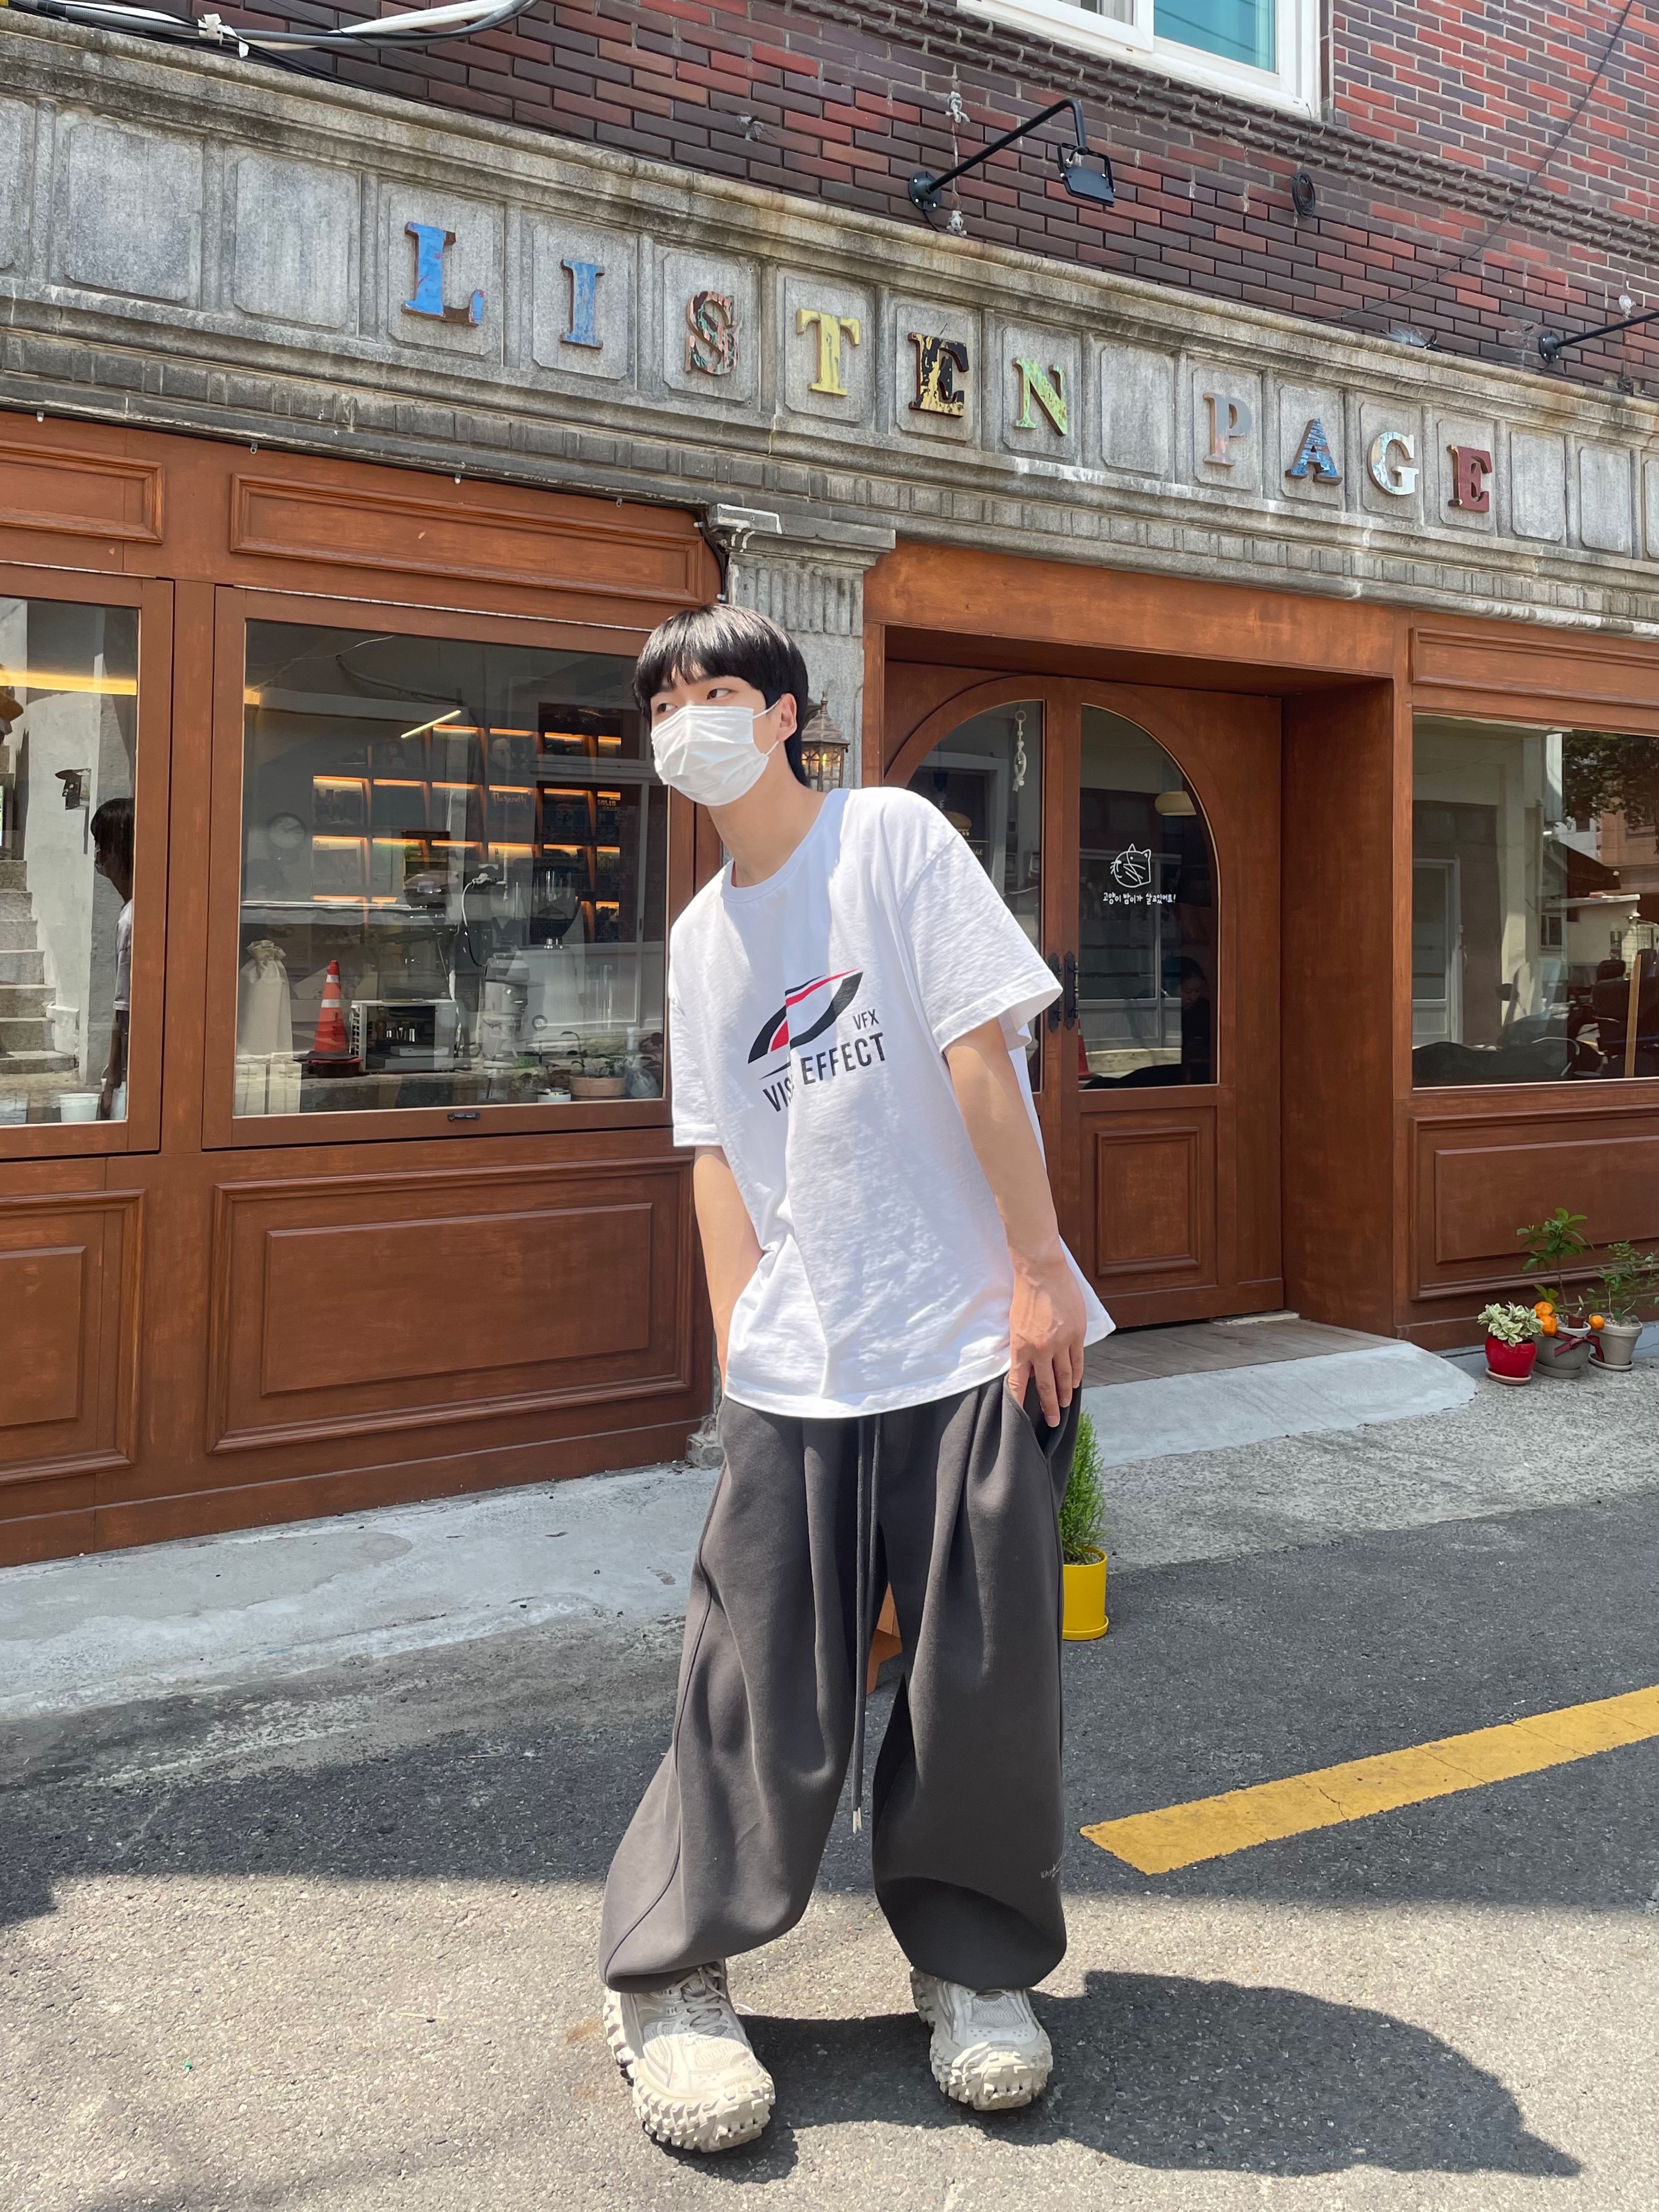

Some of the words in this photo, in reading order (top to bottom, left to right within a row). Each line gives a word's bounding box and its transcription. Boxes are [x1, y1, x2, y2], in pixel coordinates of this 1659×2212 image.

[401, 221, 1068, 436] LISTEN
[1203, 392, 1492, 513] PAGE
[1103, 892, 1122, 904] 고양이
[853, 1009, 879, 1030] VFX
[801, 1032, 885, 1085] EFFECT
